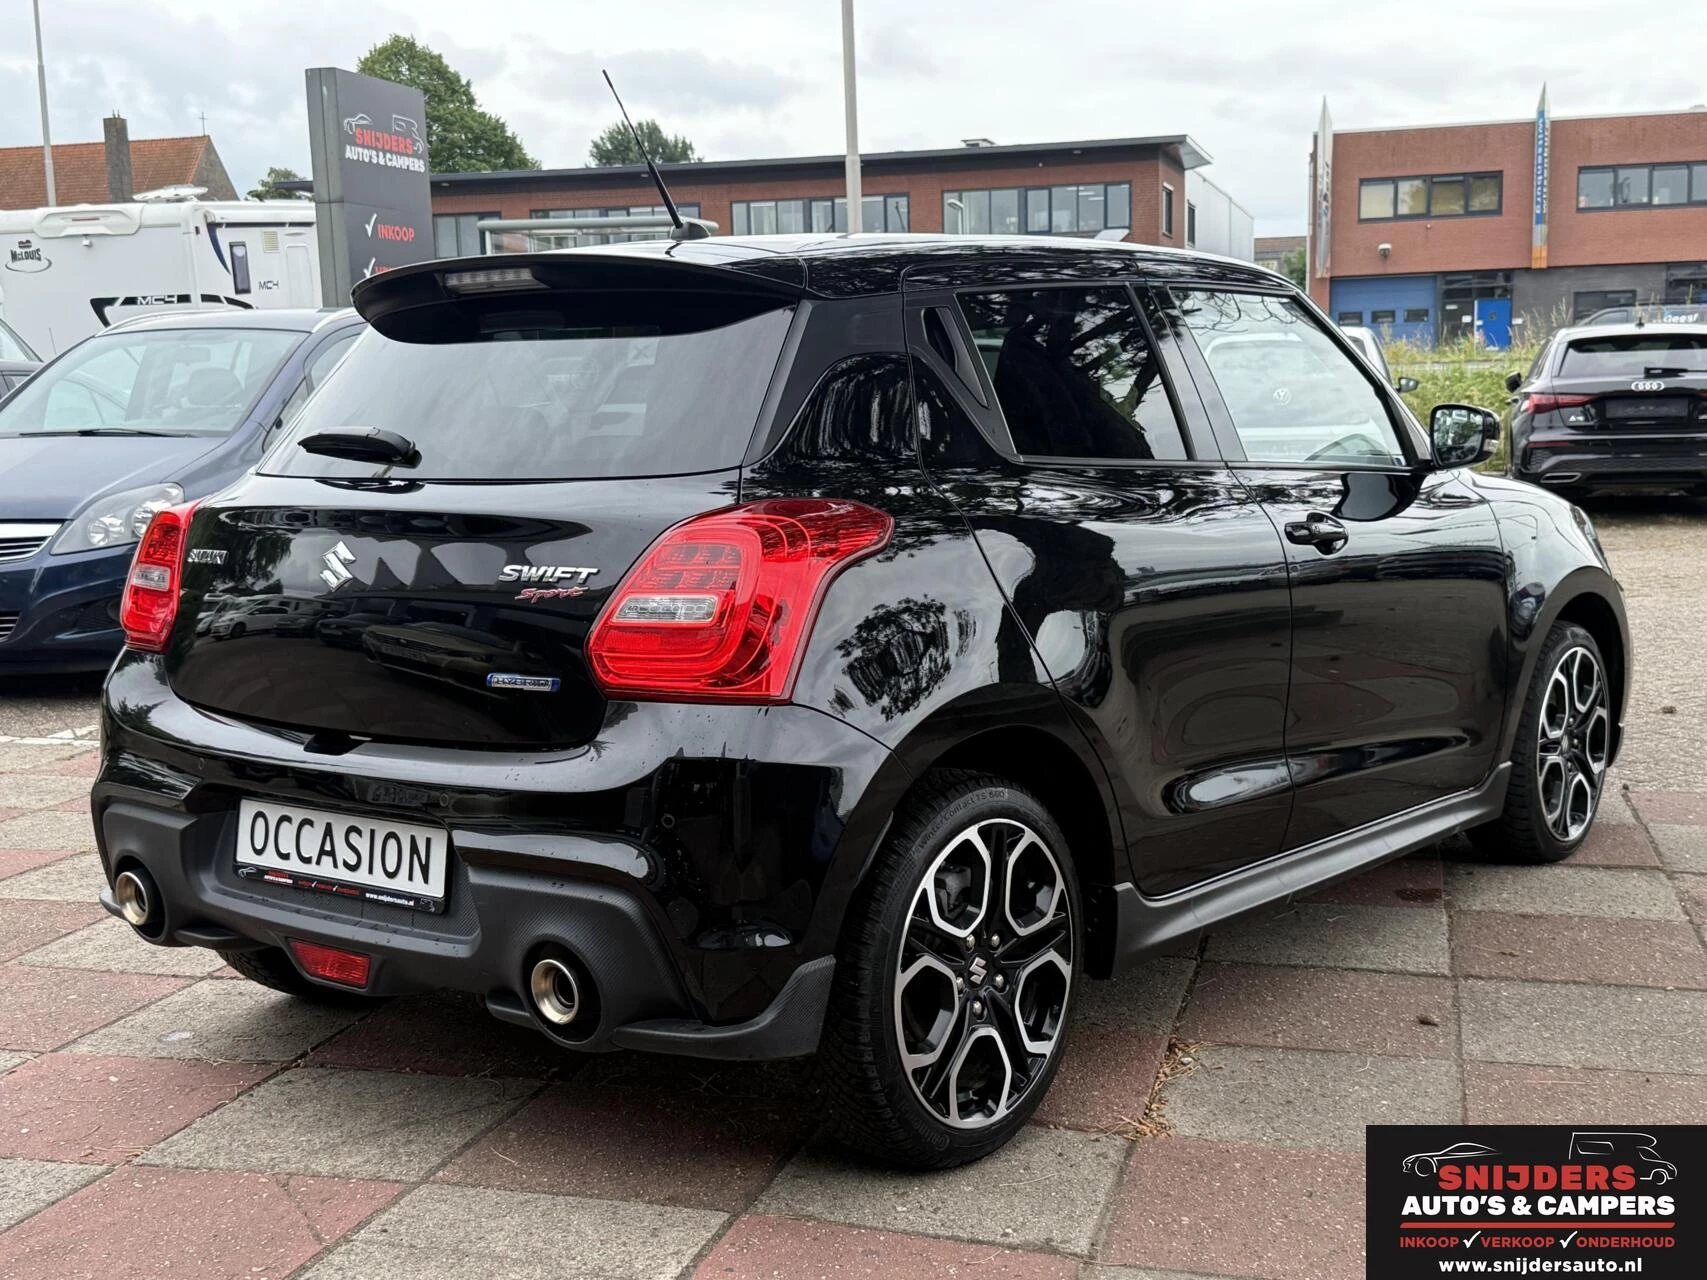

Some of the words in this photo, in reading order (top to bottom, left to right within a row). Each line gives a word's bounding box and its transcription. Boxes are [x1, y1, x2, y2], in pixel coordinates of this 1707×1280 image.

[355, 127, 414, 155] SNIJDERS
[345, 144, 378, 164] AUTO'S
[379, 152, 386, 166] &
[386, 153, 426, 173] CAMPERS
[377, 223, 415, 242] INKOOP
[259, 280, 280, 291] MC4
[137, 294, 177, 305] MC4
[498, 564, 599, 585] SWIFT
[250, 810, 433, 885] OCCASION
